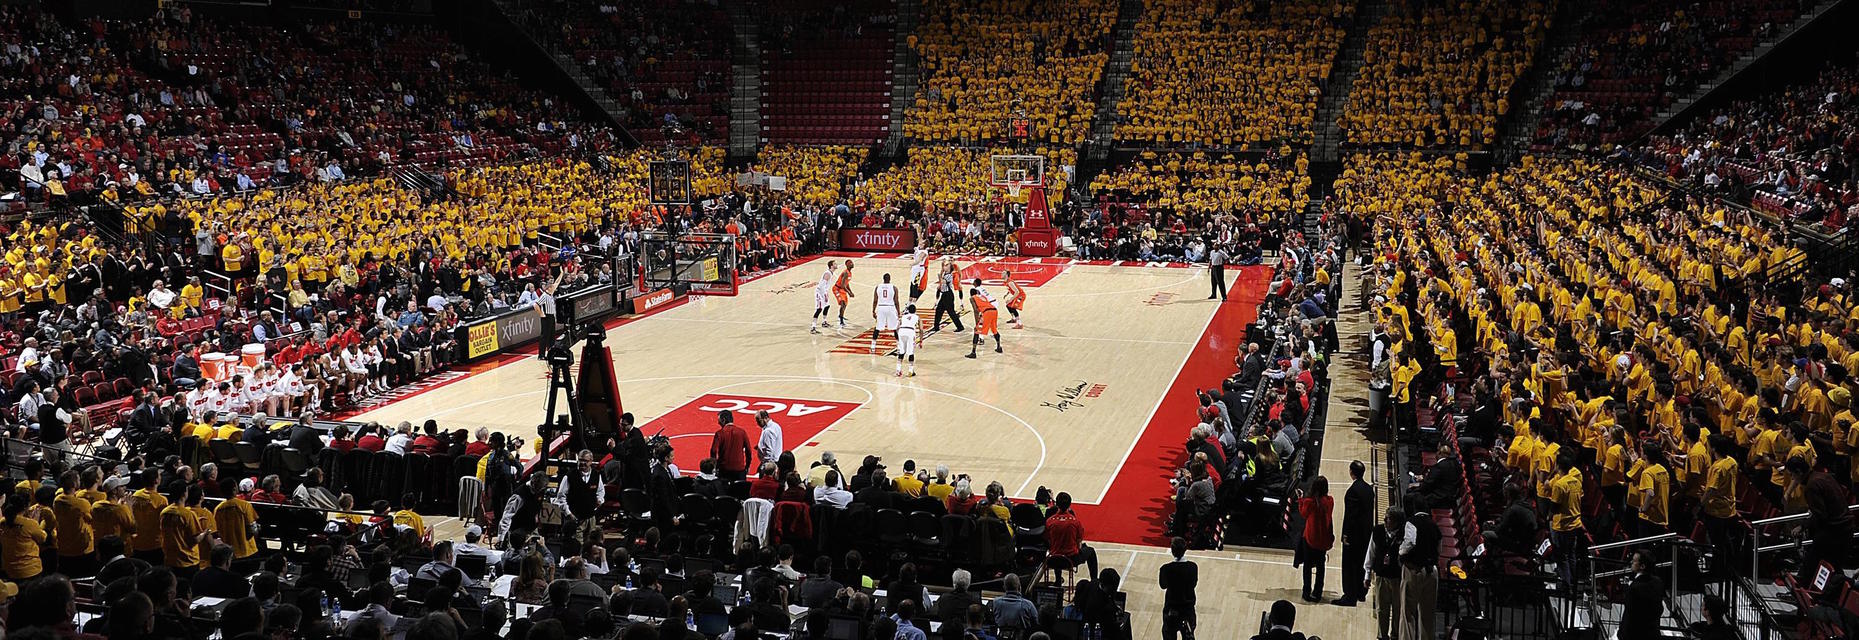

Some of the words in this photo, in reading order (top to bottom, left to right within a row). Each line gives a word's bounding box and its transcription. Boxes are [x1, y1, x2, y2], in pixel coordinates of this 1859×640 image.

[855, 231, 900, 248] xfinity
[1024, 237, 1049, 249] xfinity
[469, 323, 496, 343] OLLIE'S
[502, 316, 534, 341] xfinity
[474, 343, 492, 354] OUTLET
[699, 399, 839, 417] ACC
